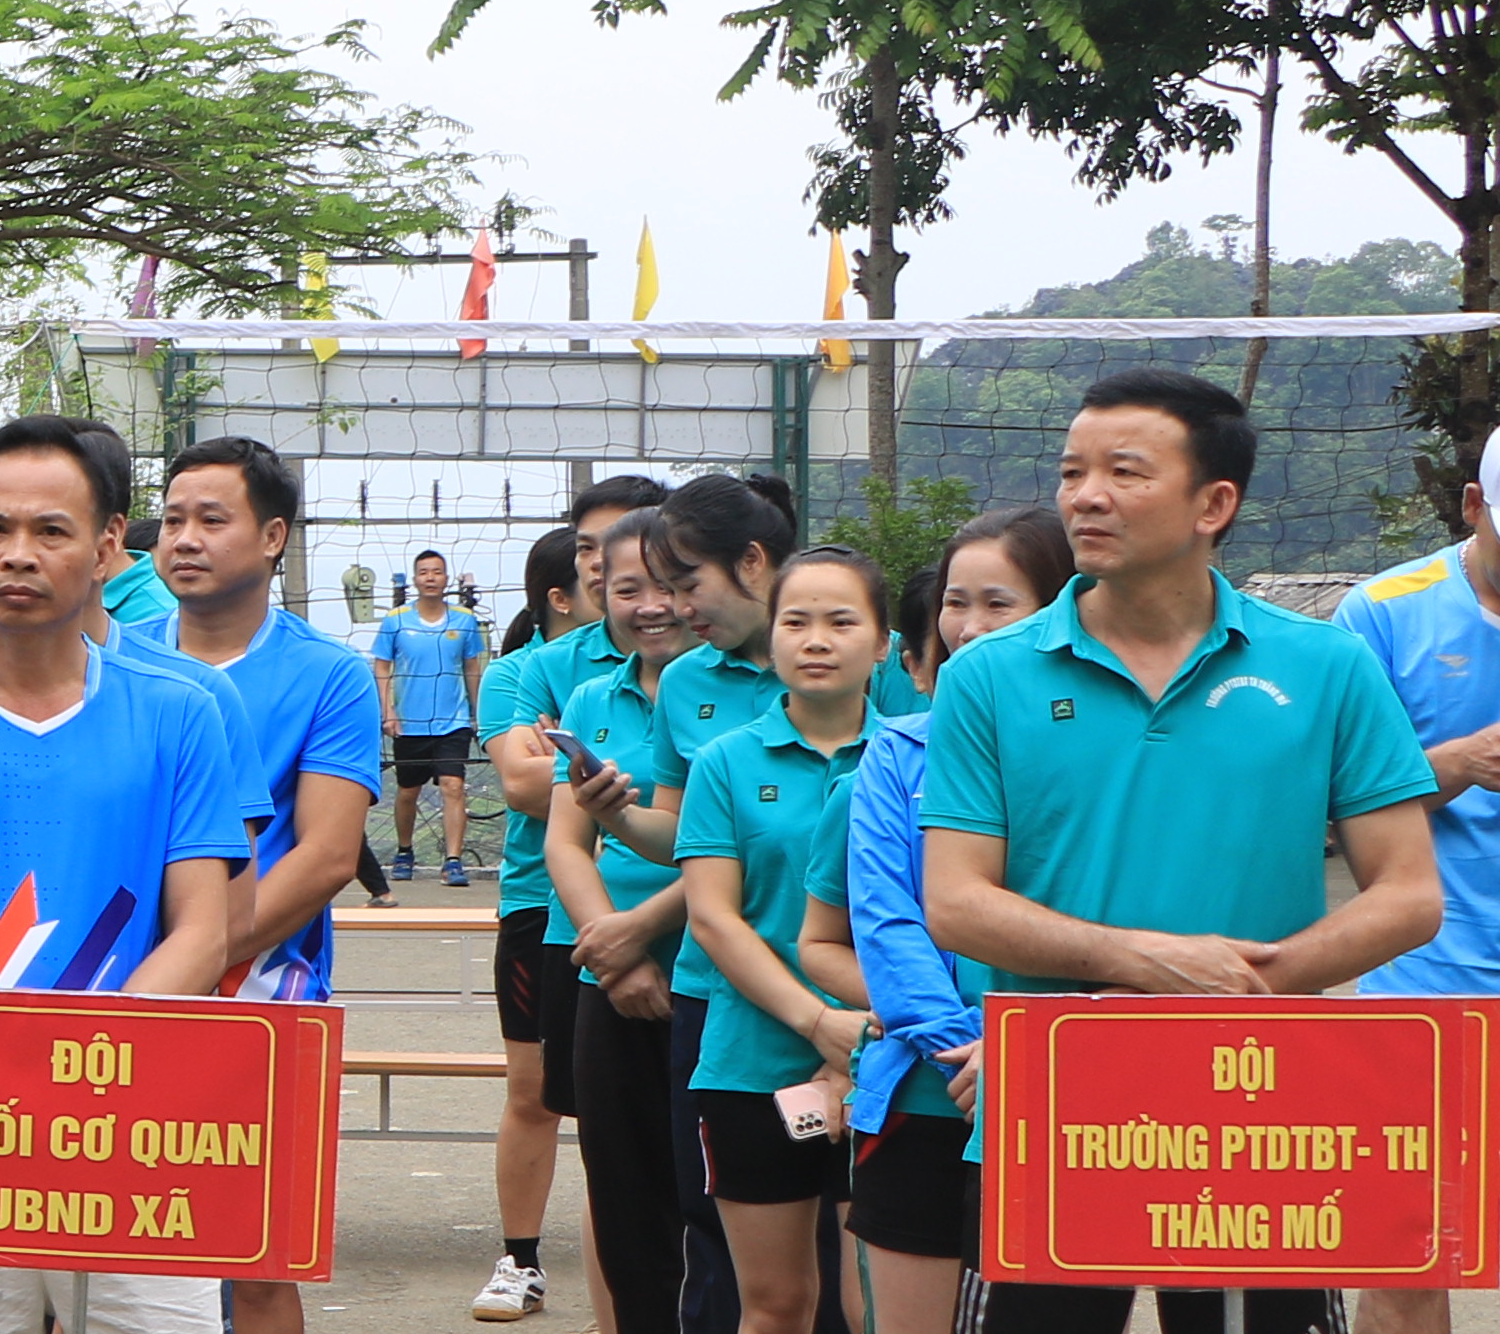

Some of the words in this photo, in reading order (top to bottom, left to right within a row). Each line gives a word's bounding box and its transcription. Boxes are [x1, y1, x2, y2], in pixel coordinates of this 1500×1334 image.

[50, 1032, 133, 1095] ĐỘI
[1211, 1036, 1275, 1102] ĐỘI
[49, 1113, 117, 1162] CƠ
[130, 1119, 262, 1168] QUAN
[1061, 1113, 1209, 1170] TRƯỜNG
[1221, 1125, 1372, 1171] PTDTBT-
[1382, 1125, 1428, 1171] TH
[128, 1187, 195, 1239] XÃ
[1146, 1186, 1270, 1250] THẮNG
[1282, 1188, 1343, 1250] MỐ
